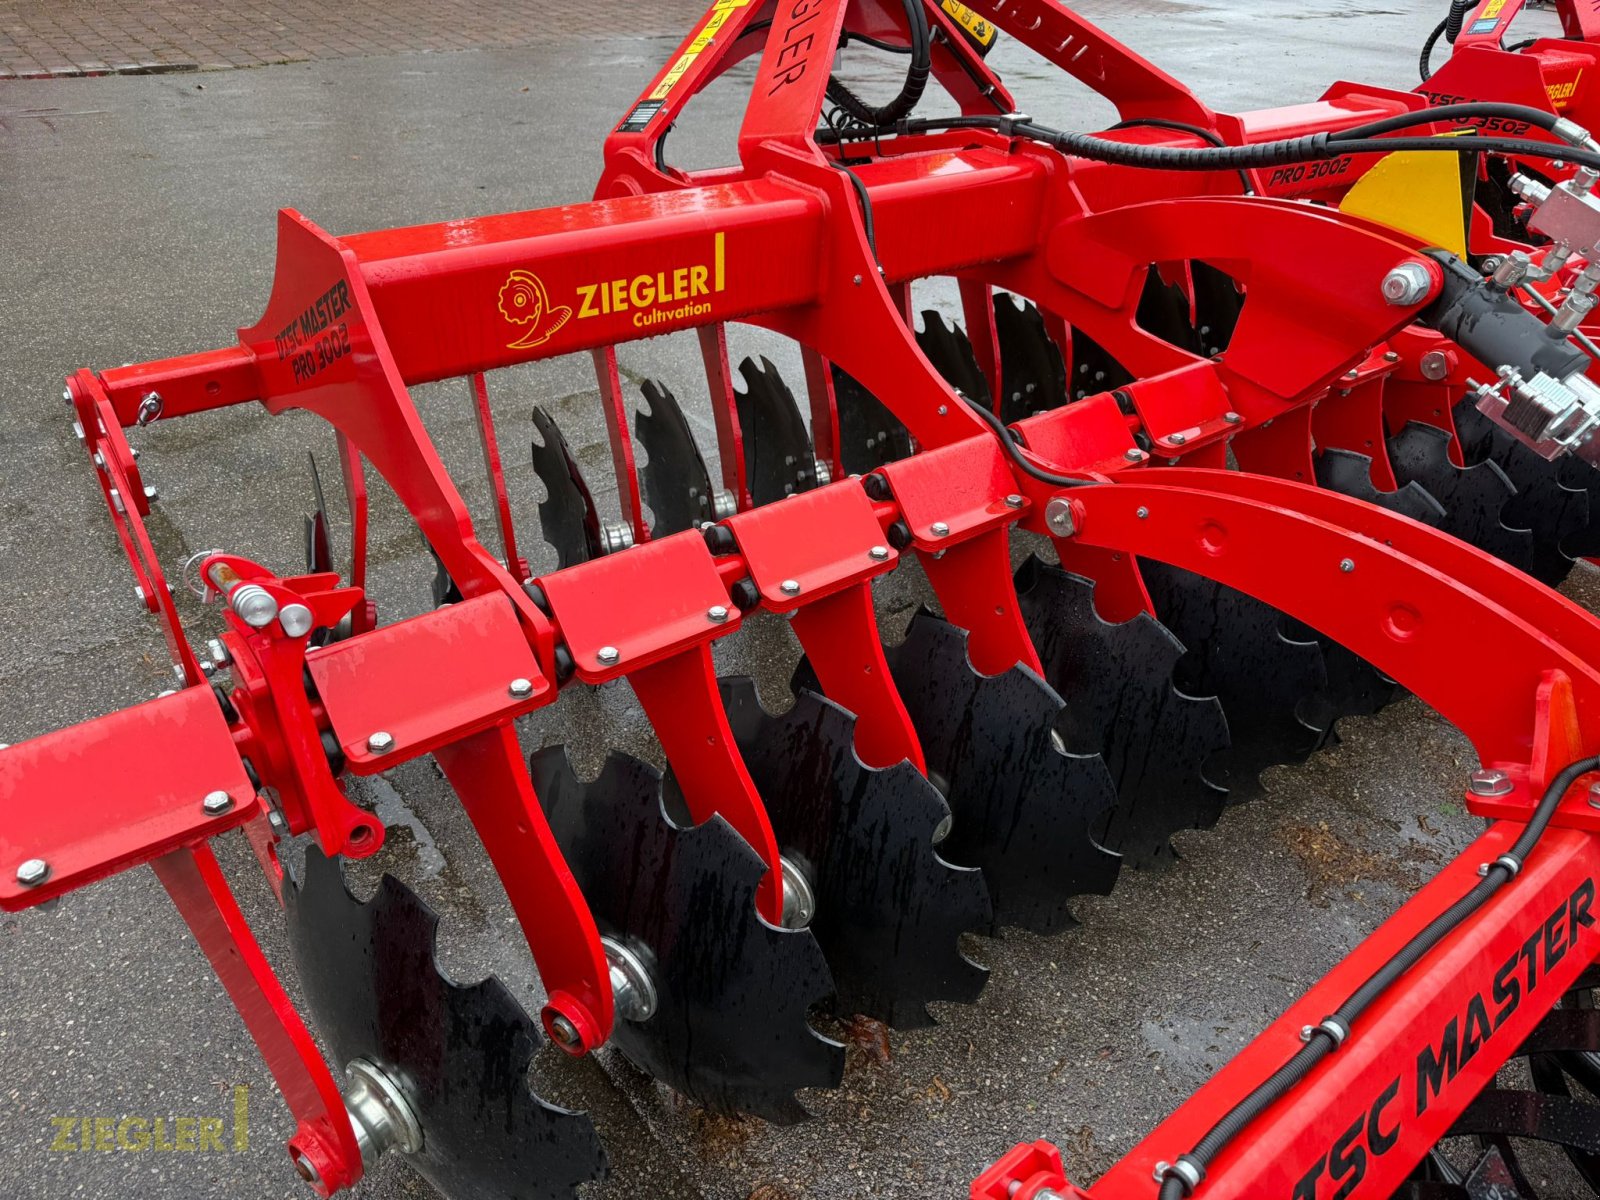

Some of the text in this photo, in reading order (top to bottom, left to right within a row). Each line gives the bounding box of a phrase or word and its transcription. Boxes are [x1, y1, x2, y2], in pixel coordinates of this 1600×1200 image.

[1268, 157, 1352, 187] PRO 3002
[275, 279, 352, 361] DISC MASTER
[576, 265, 709, 319] ZIEGLER
[633, 301, 712, 327] Cultivation
[292, 322, 351, 385] PRO 3002
[1416, 877, 1597, 1119] MASTER
